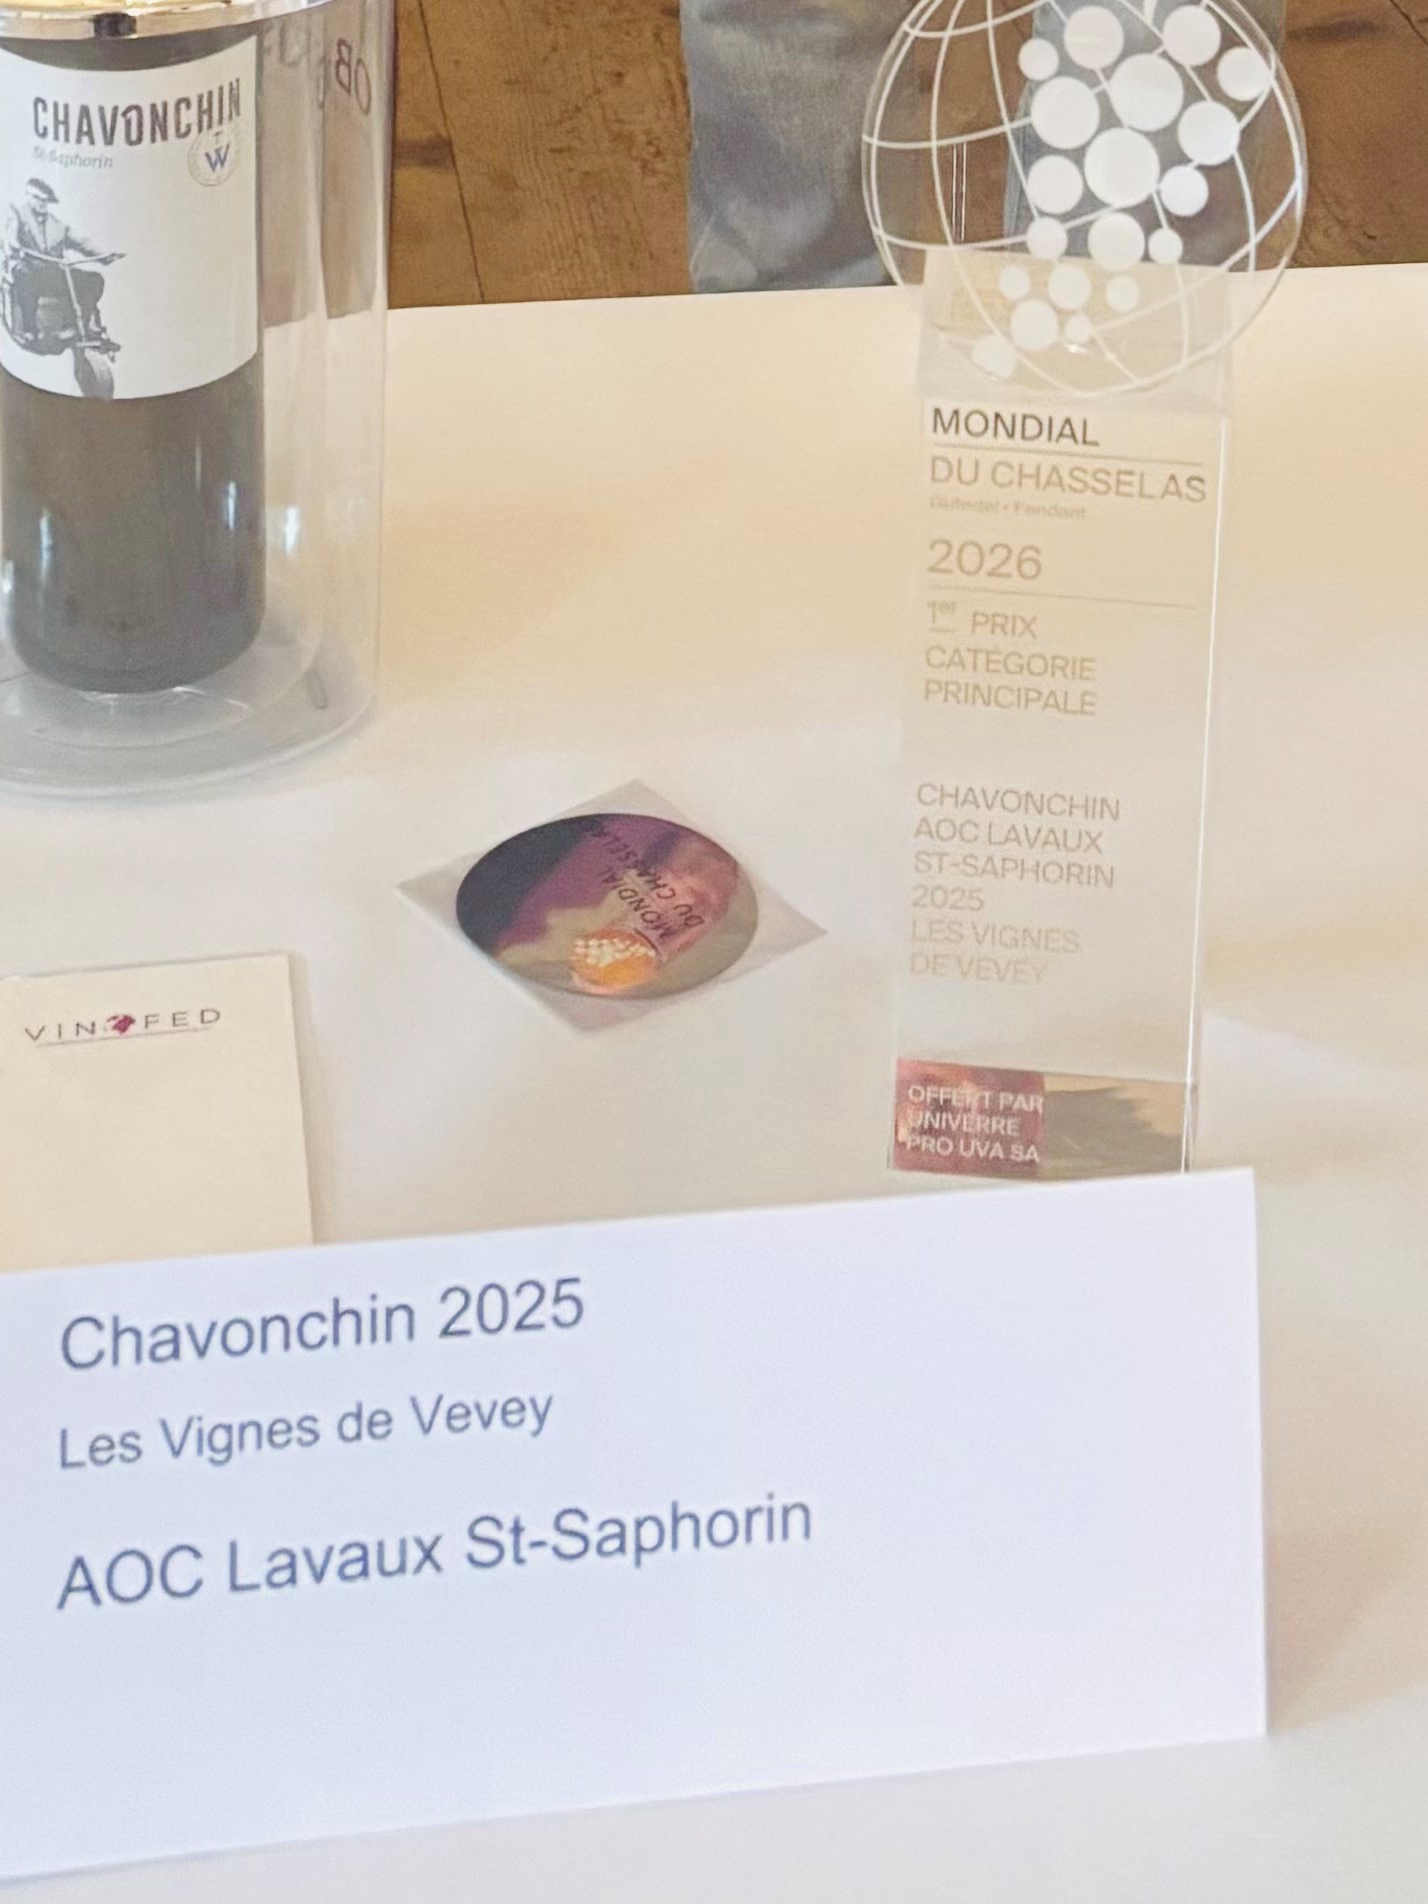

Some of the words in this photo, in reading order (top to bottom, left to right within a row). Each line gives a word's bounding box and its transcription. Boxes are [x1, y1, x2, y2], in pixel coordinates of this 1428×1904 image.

[32, 77, 242, 148] CHAVONCHIN
[932, 406, 1101, 448] MONDIAL
[929, 455, 980, 486] DU
[990, 460, 1207, 504] CHASSELAS
[926, 537, 1044, 581] 2026
[970, 611, 1038, 640] PRIX
[924, 678, 1099, 717] PRINCIPALE
[916, 782, 1121, 822] CHAVONCHIN
[913, 816, 980, 843] AOC
[987, 821, 1103, 855] LAVAUX
[913, 850, 1115, 889] ST-SAPHORIN
[911, 884, 985, 912] 2025
[911, 918, 965, 944] LES
[972, 922, 1081, 954] VIGNES
[956, 954, 1048, 984] VEVEY
[908, 1084, 991, 1109] OFFERT
[998, 1091, 1044, 1115] PAR
[906, 1134, 954, 1156] PRO
[959, 1139, 1005, 1161] UVA
[1010, 1143, 1040, 1163] SA
[60, 1294, 415, 1370] Chavonchin
[438, 1276, 584, 1339] 2025
[60, 1425, 143, 1469] Les
[160, 1413, 321, 1467] Vignes
[336, 1401, 394, 1443] de
[410, 1391, 555, 1440] Vevey
[56, 1542, 204, 1611] AOC
[228, 1533, 442, 1593] Lavaux
[466, 1495, 812, 1569] St-Saphorin
